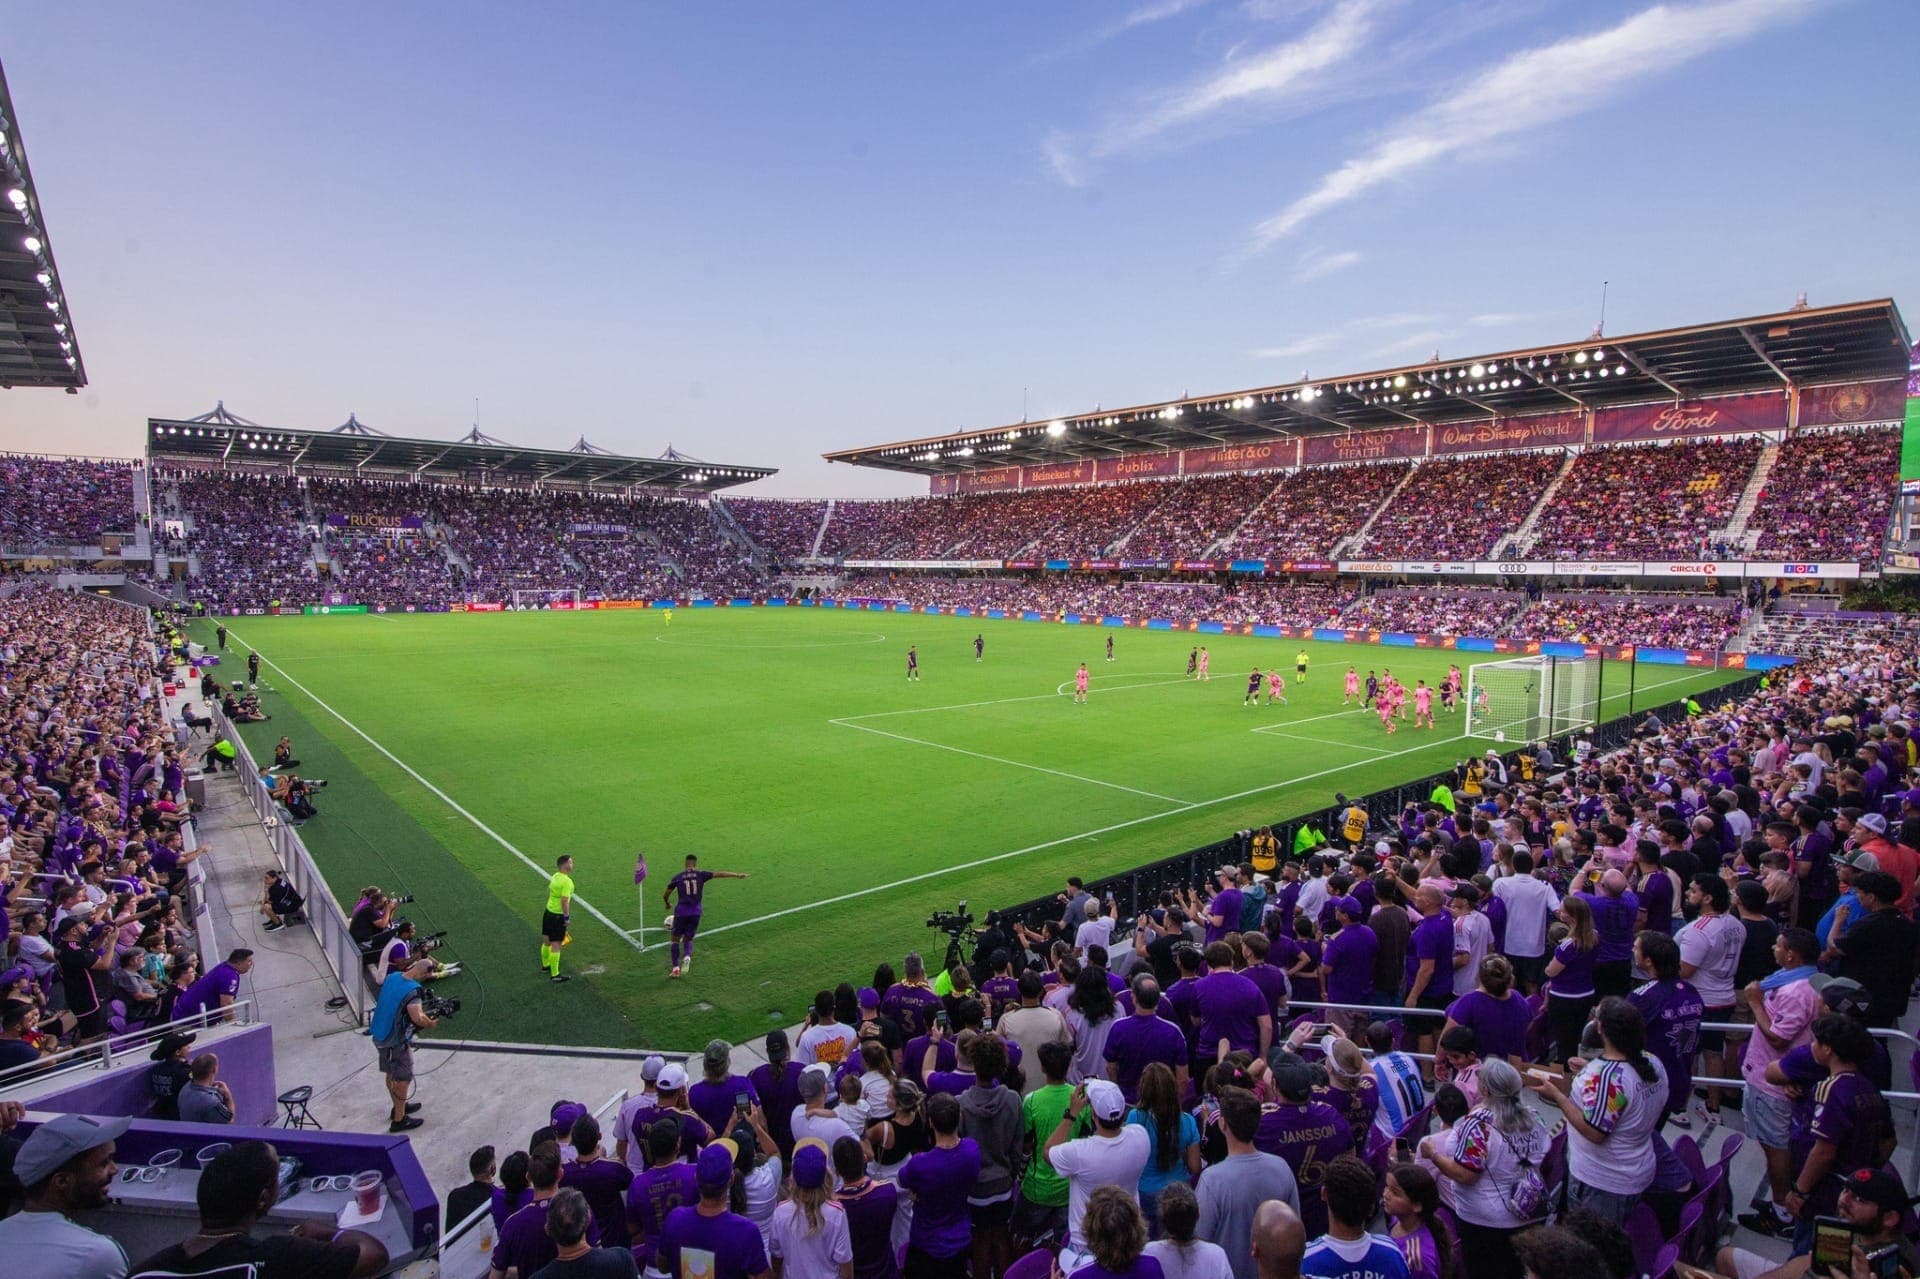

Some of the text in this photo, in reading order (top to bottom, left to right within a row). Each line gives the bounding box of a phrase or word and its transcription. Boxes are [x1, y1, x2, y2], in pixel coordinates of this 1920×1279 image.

[1652, 407, 1718, 431] Ford
[1530, 422, 1570, 437] World
[1332, 433, 1394, 449] ORLANDO
[1339, 445, 1385, 460] HEALTH
[1116, 461, 1155, 474] Publix
[1032, 471, 1071, 482] Heineken
[350, 515, 402, 527] RUCKUS
[1670, 564, 1716, 574] CIRCLE K
[1347, 817, 1365, 828] 052
[683, 879, 698, 896] 11
[1396, 1073, 1425, 1118] 10
[1278, 1124, 1337, 1144] JANSSON
[1299, 1145, 1328, 1185] 6
